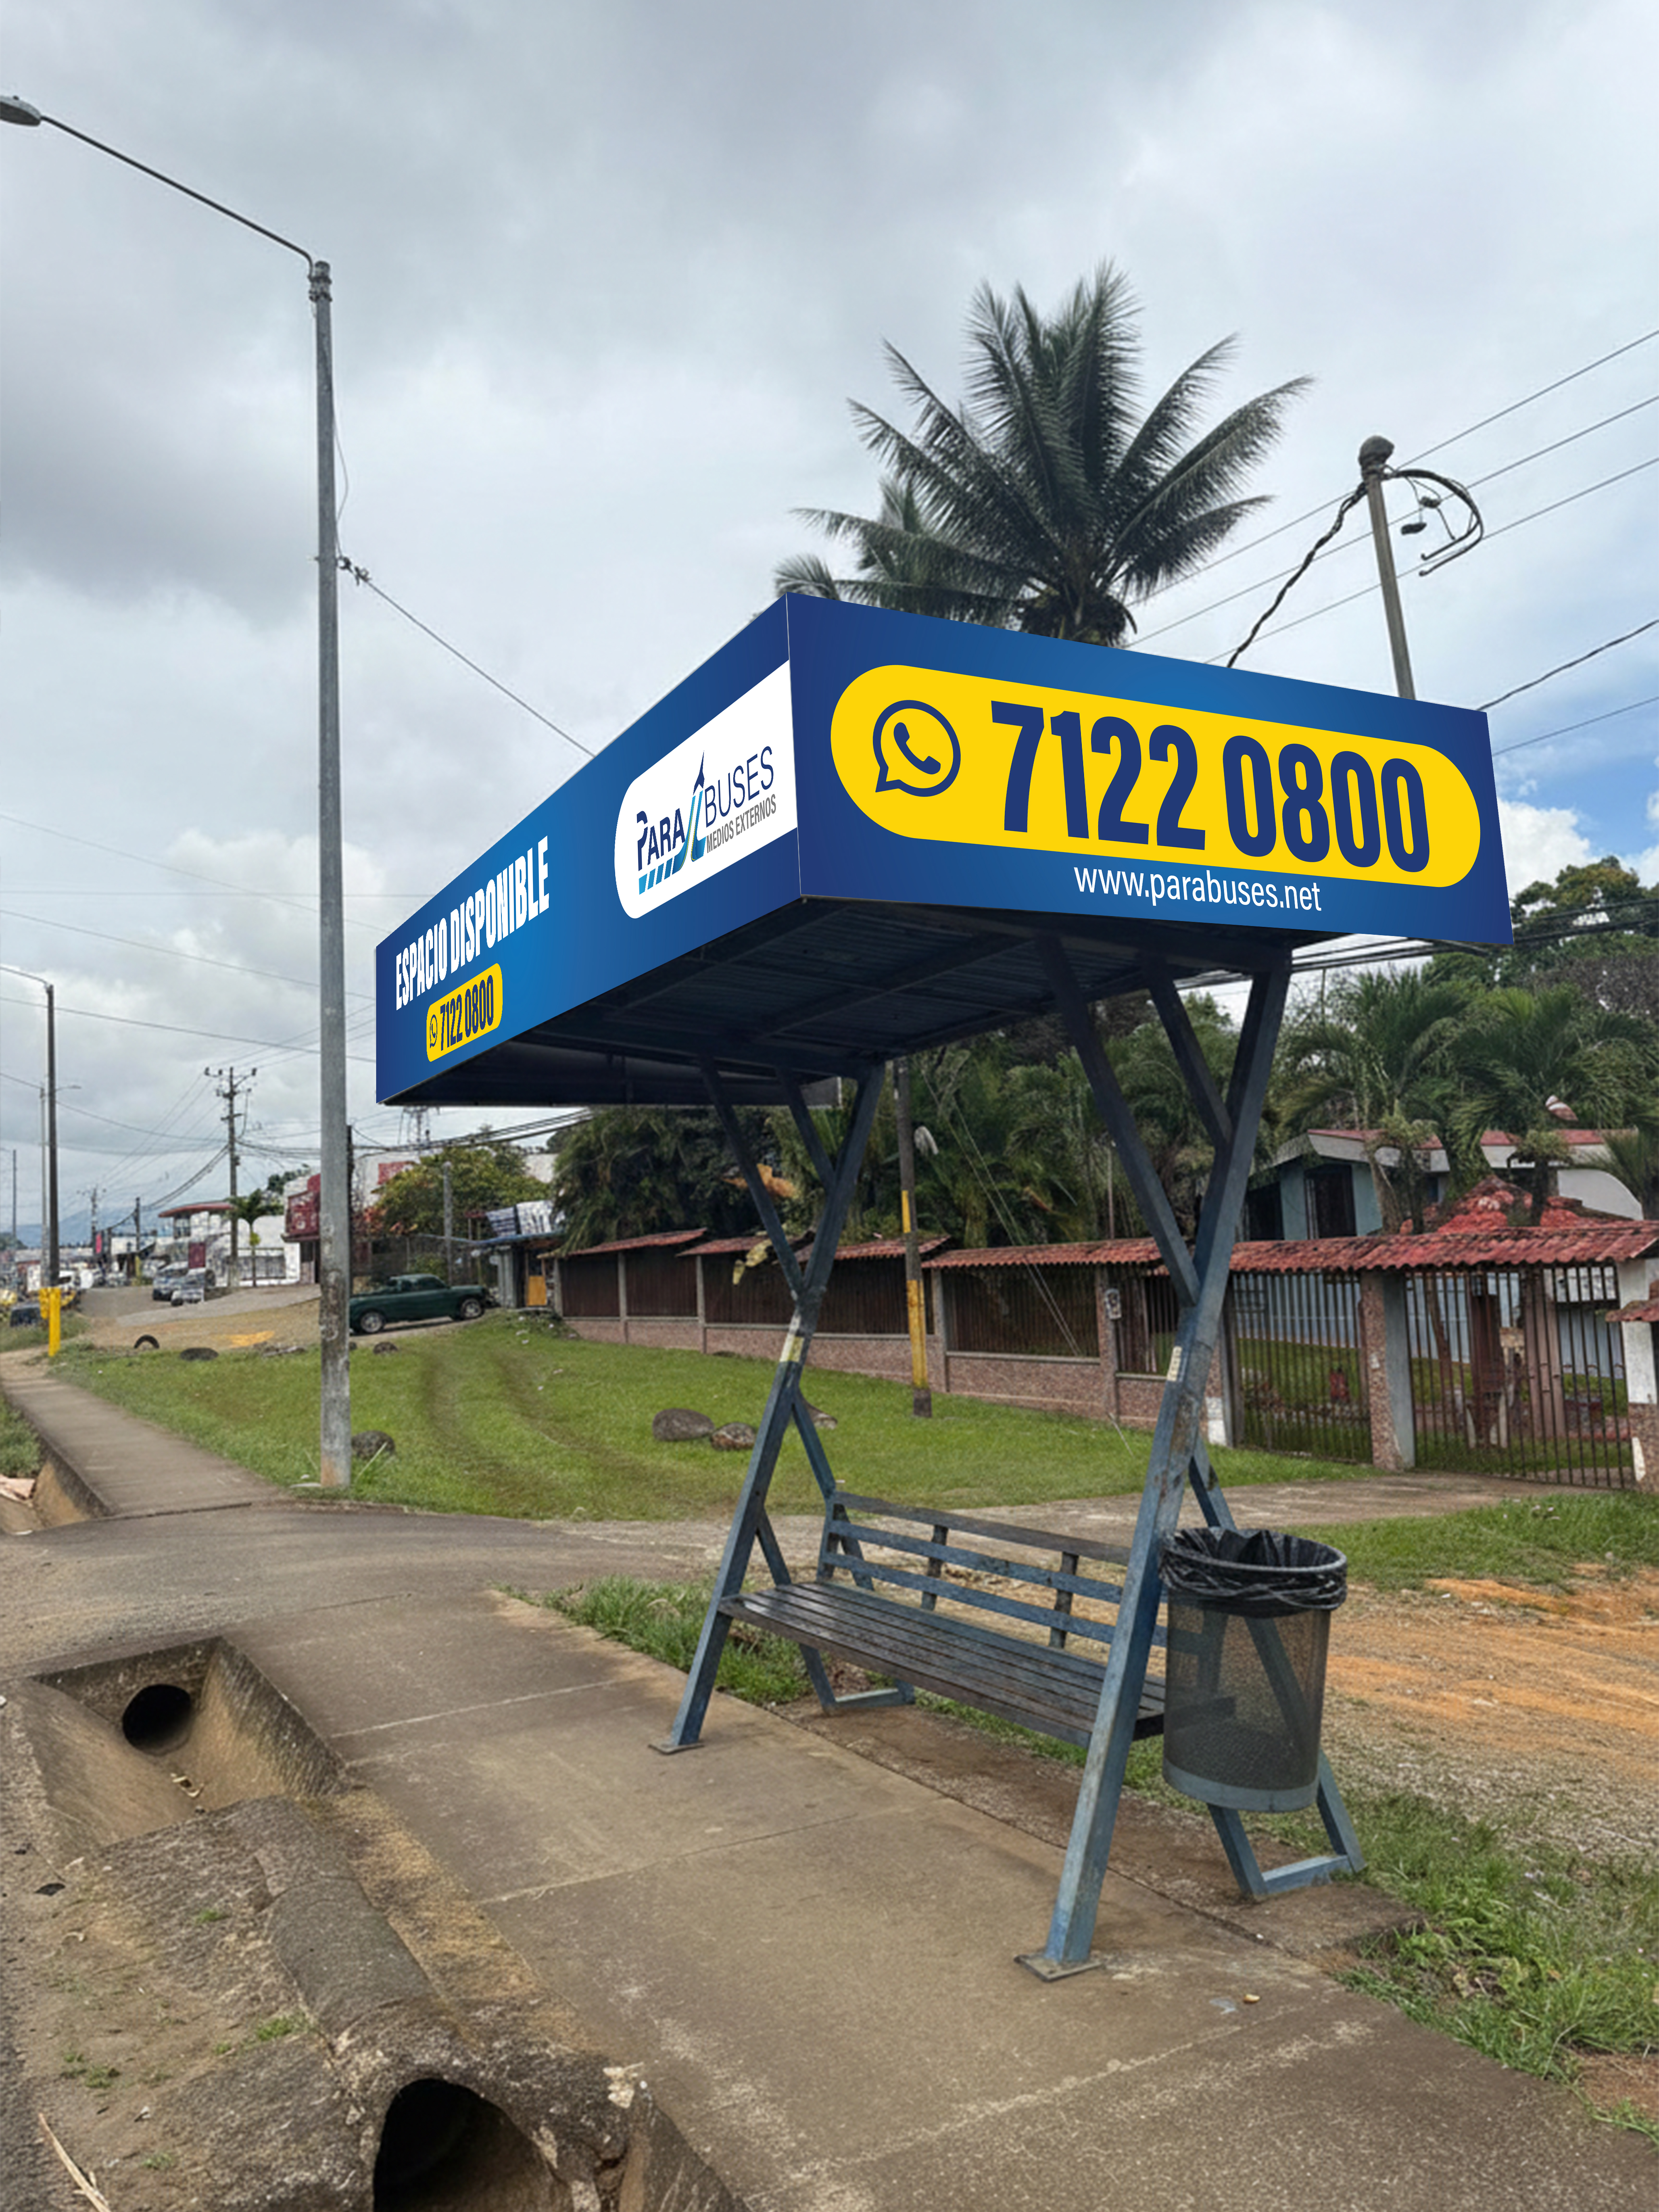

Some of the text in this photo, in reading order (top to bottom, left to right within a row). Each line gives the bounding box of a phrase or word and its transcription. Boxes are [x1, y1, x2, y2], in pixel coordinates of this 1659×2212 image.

[706, 794, 776, 853] MEDIOS EXTERNOS
[990, 700, 1430, 873] 7122 0800
[396, 835, 550, 1011] ESPACIO DISPONIBLE
[1073, 866, 1322, 911] www.parabuses.net
[439, 975, 494, 1051] 7122 0800
